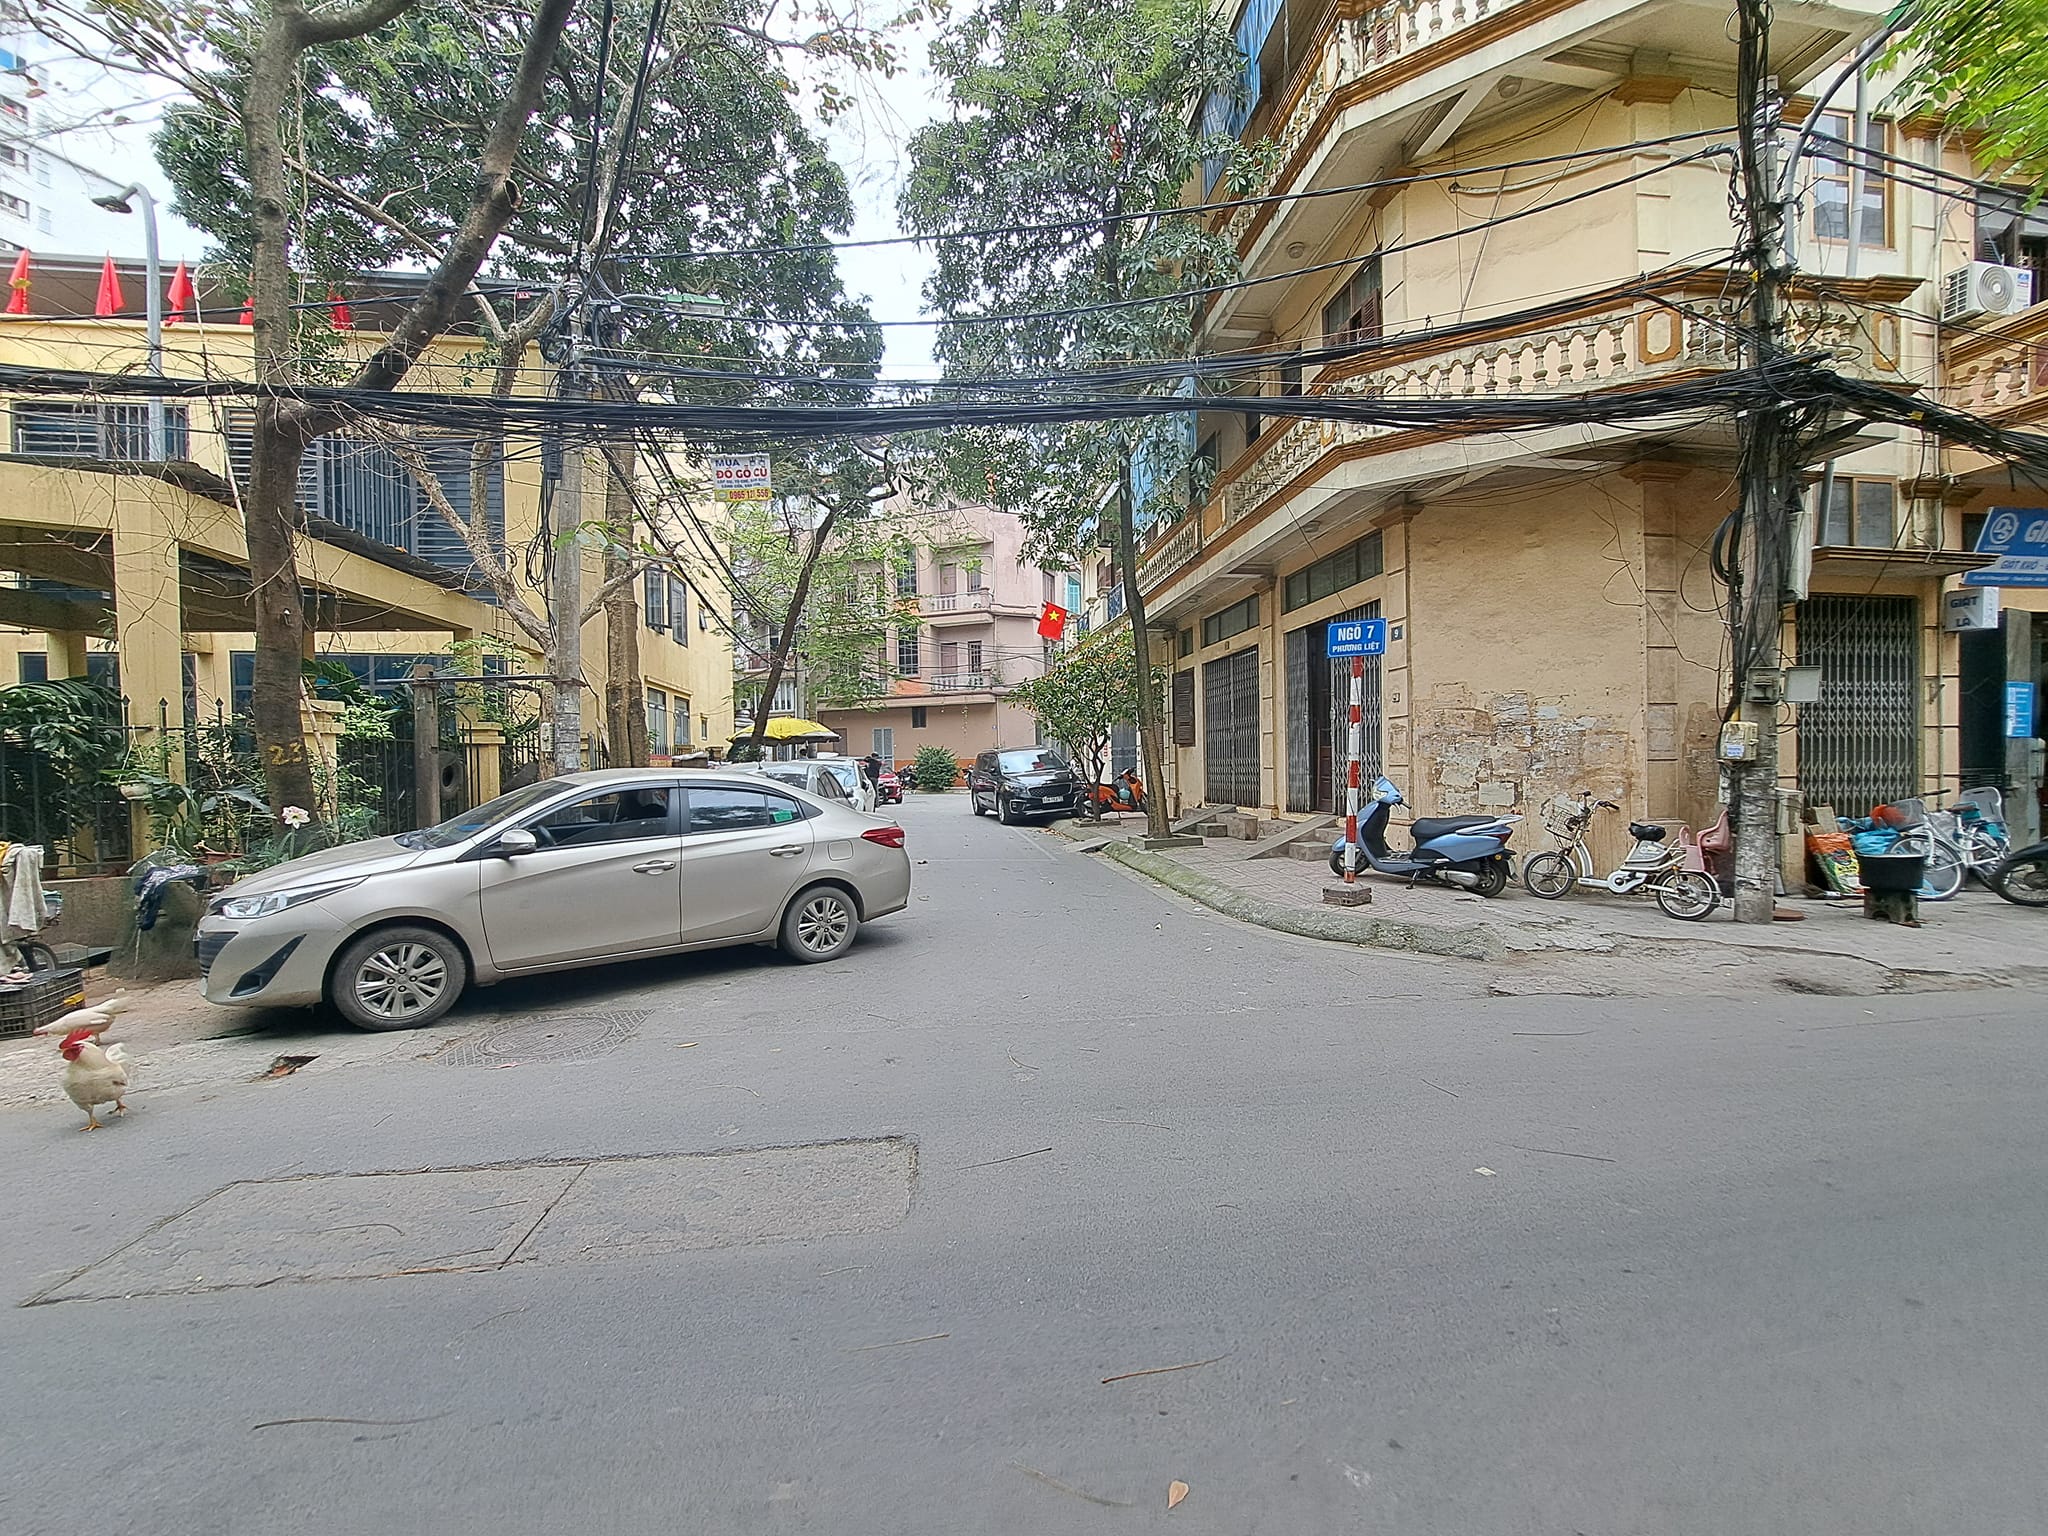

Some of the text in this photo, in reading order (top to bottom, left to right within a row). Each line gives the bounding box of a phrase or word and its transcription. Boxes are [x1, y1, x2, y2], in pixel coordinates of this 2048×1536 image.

[716, 465, 767, 478] ĐỒ GỖ CŨ
[1338, 622, 1374, 641] NGÕ 7
[1332, 641, 1380, 652] PHƯƠNG LIỆT
[267, 742, 303, 766] 23
